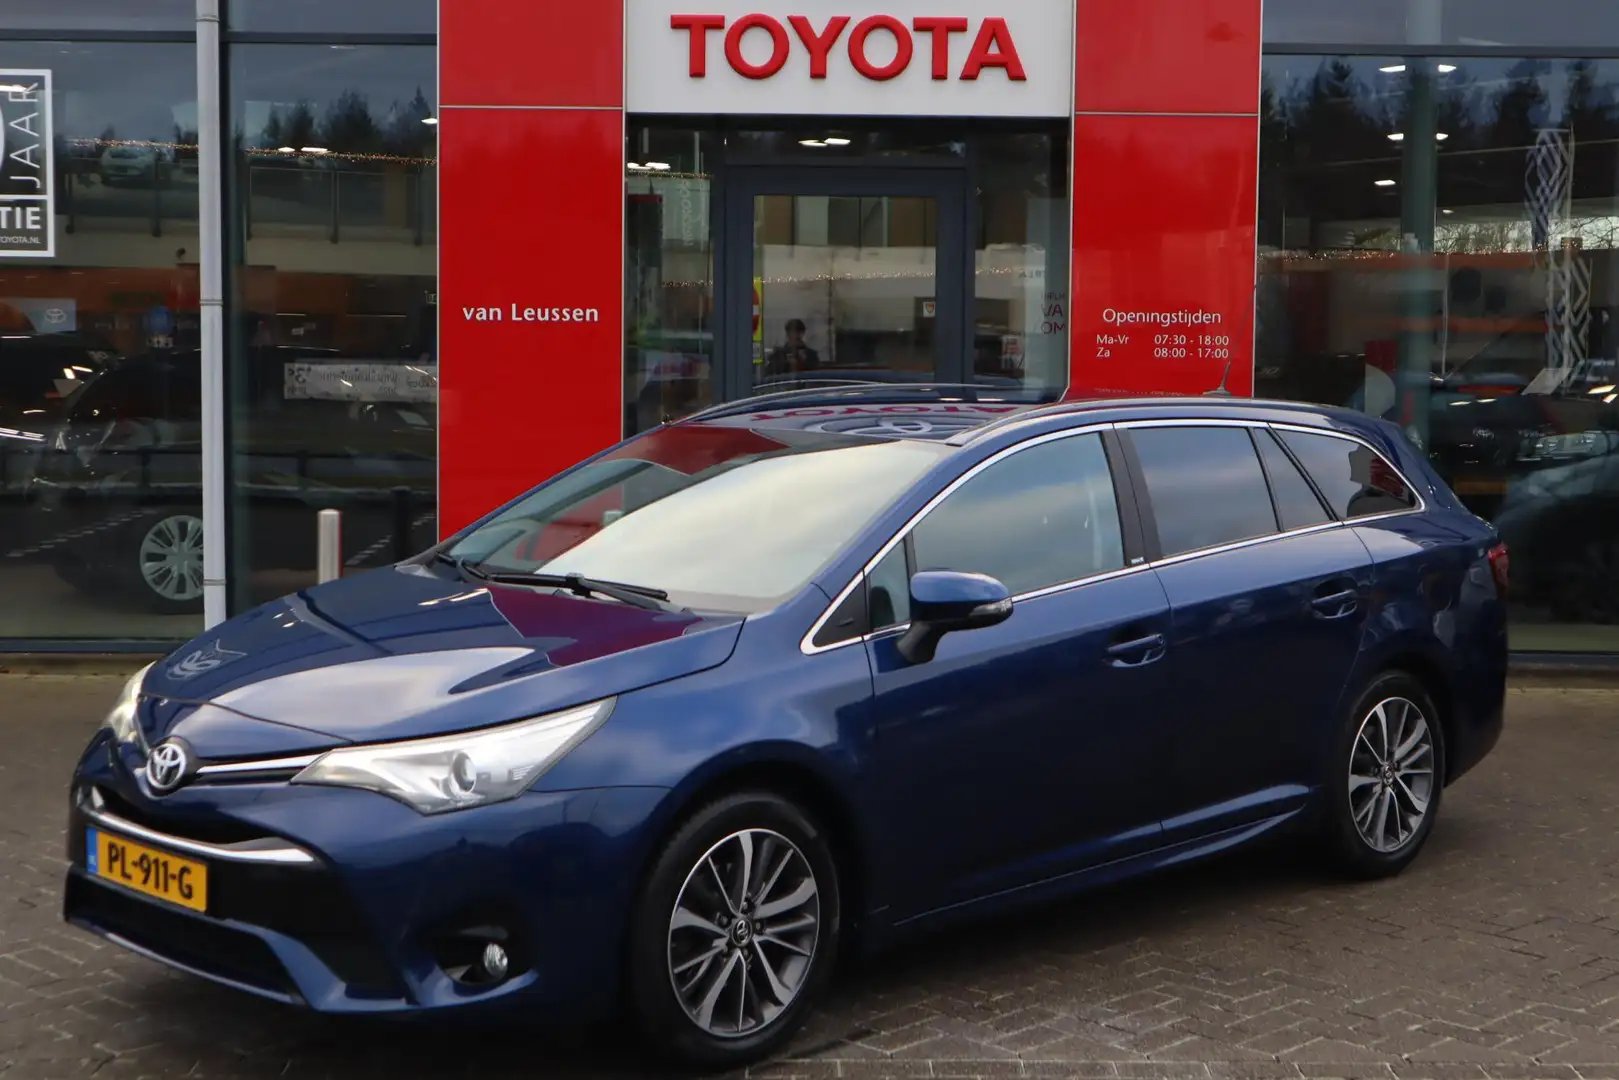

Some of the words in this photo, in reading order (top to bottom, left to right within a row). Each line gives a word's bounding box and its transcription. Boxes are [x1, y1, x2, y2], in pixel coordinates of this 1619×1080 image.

[670, 13, 1027, 81] TOYOTA
[9, 82, 40, 188] JAAR
[0, 206, 41, 229] TIE
[0, 235, 41, 244] OYOTA.NL
[462, 306, 502, 321] van
[511, 303, 599, 322] Leussen
[1102, 308, 1221, 327] Openingstijden
[1096, 334, 1130, 344] Ma-Vr
[1154, 334, 1187, 345] 07:30
[1197, 335, 1229, 346] 18:00
[1095, 346, 1111, 358] Za
[1153, 347, 1186, 358] 08:00
[1197, 347, 1229, 359] 17:00
[107, 840, 194, 900] PL-911-G
